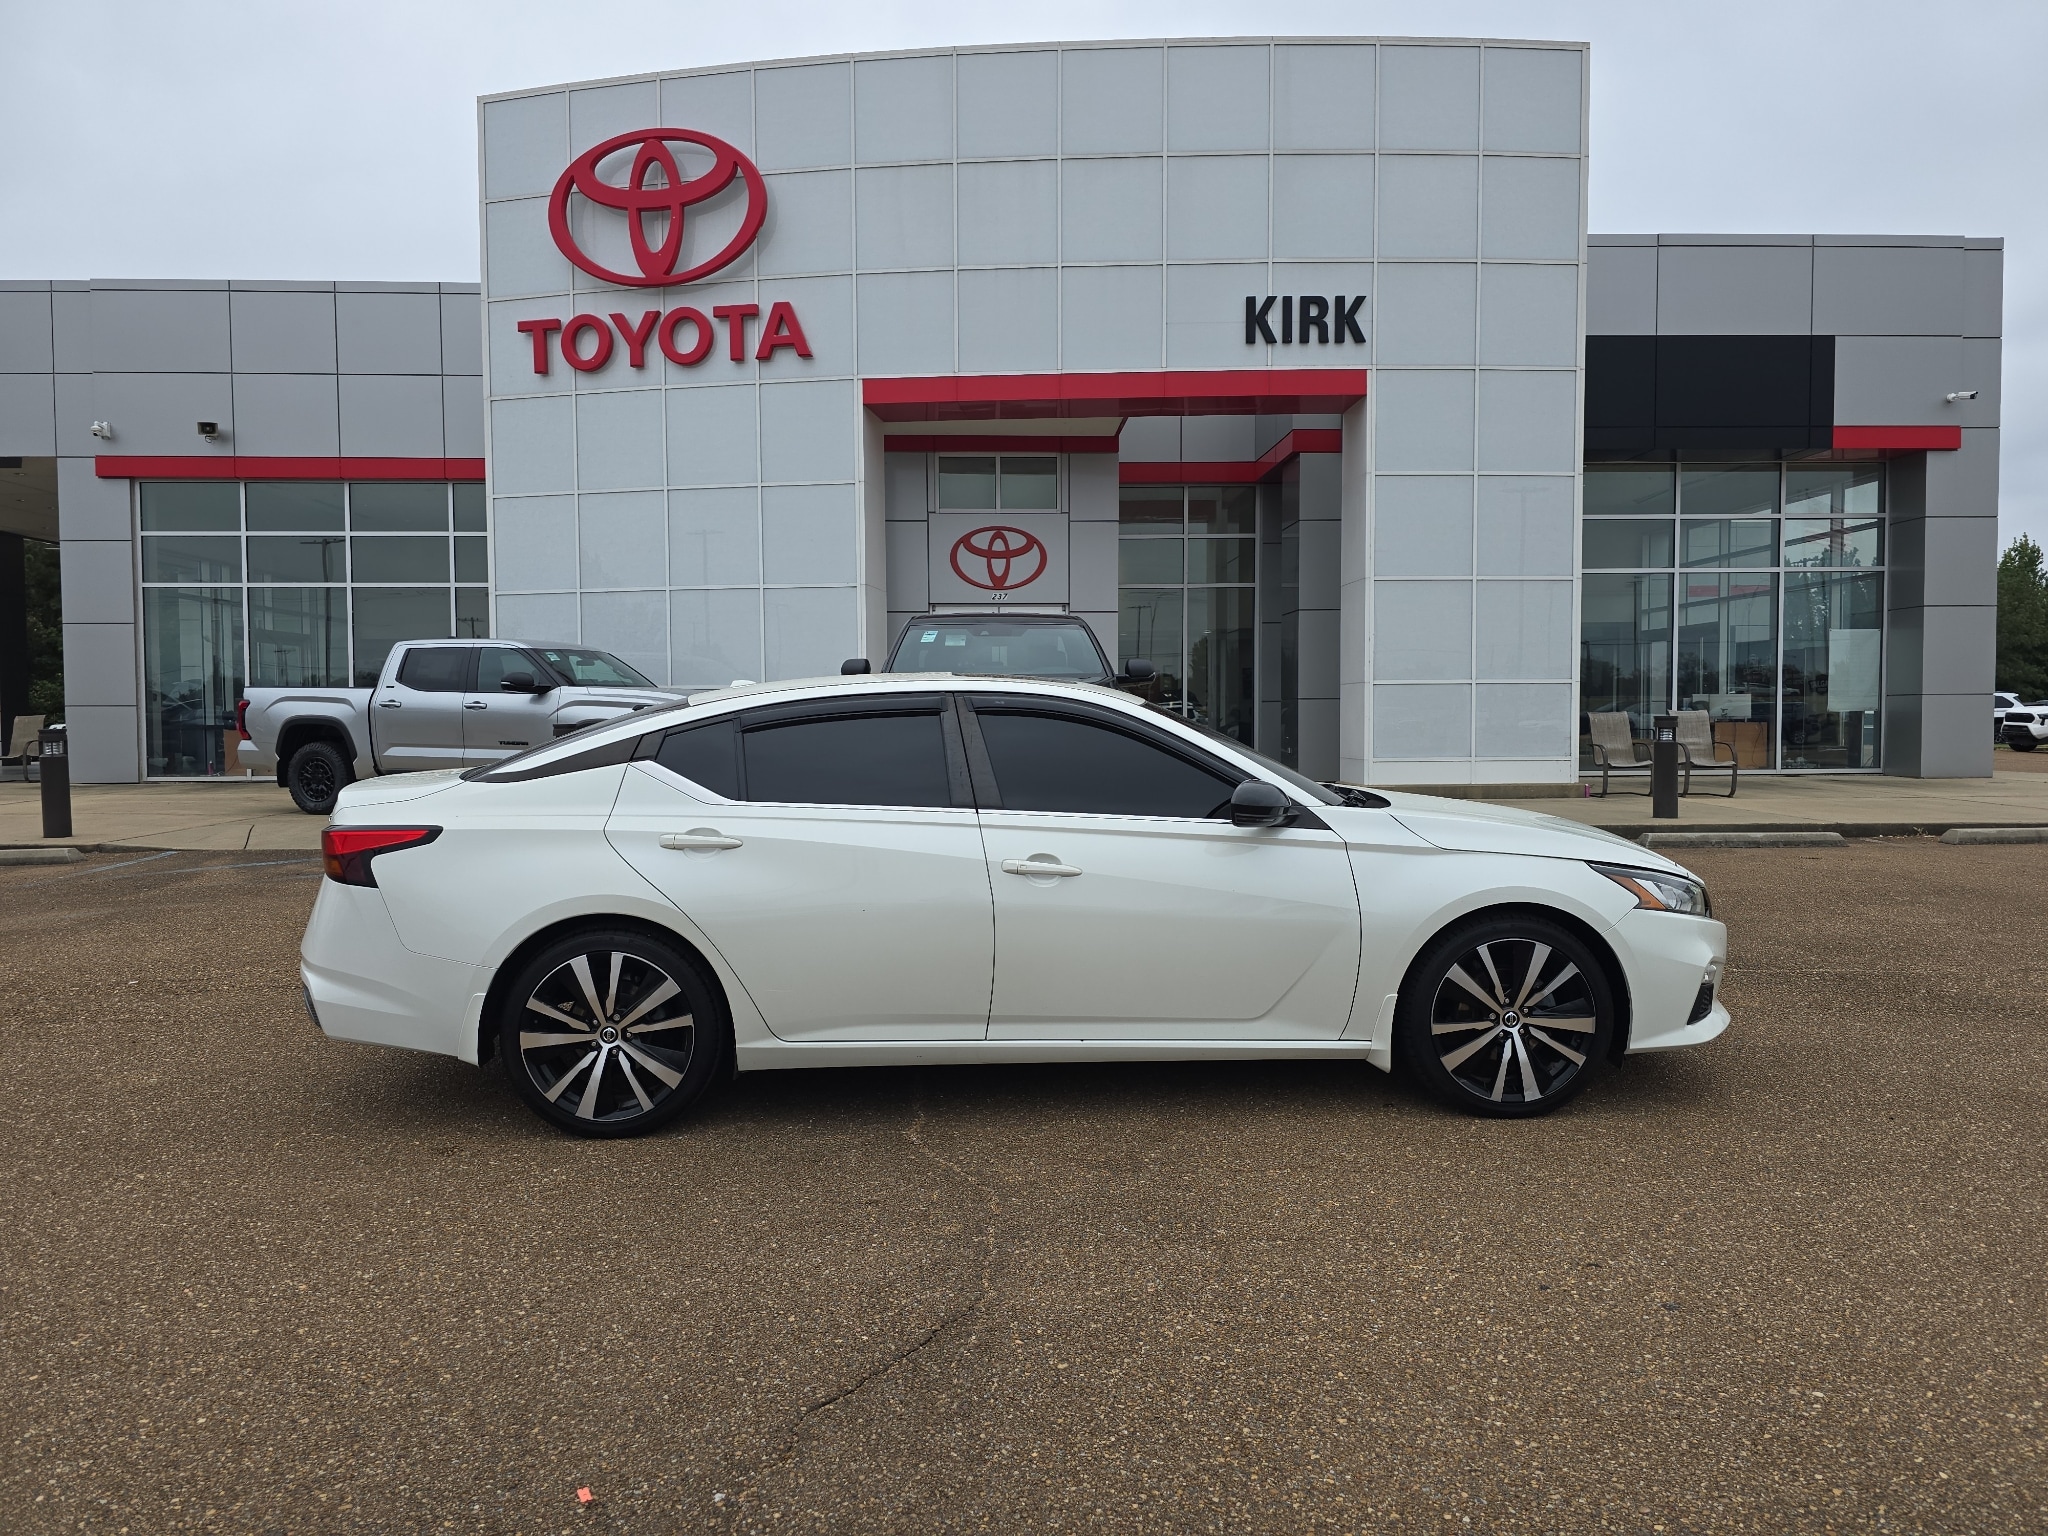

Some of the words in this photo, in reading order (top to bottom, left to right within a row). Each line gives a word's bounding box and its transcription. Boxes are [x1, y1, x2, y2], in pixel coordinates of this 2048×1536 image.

[517, 301, 814, 375] TOYOTA
[1245, 295, 1367, 344] KIRK
[991, 592, 1008, 601] 237
